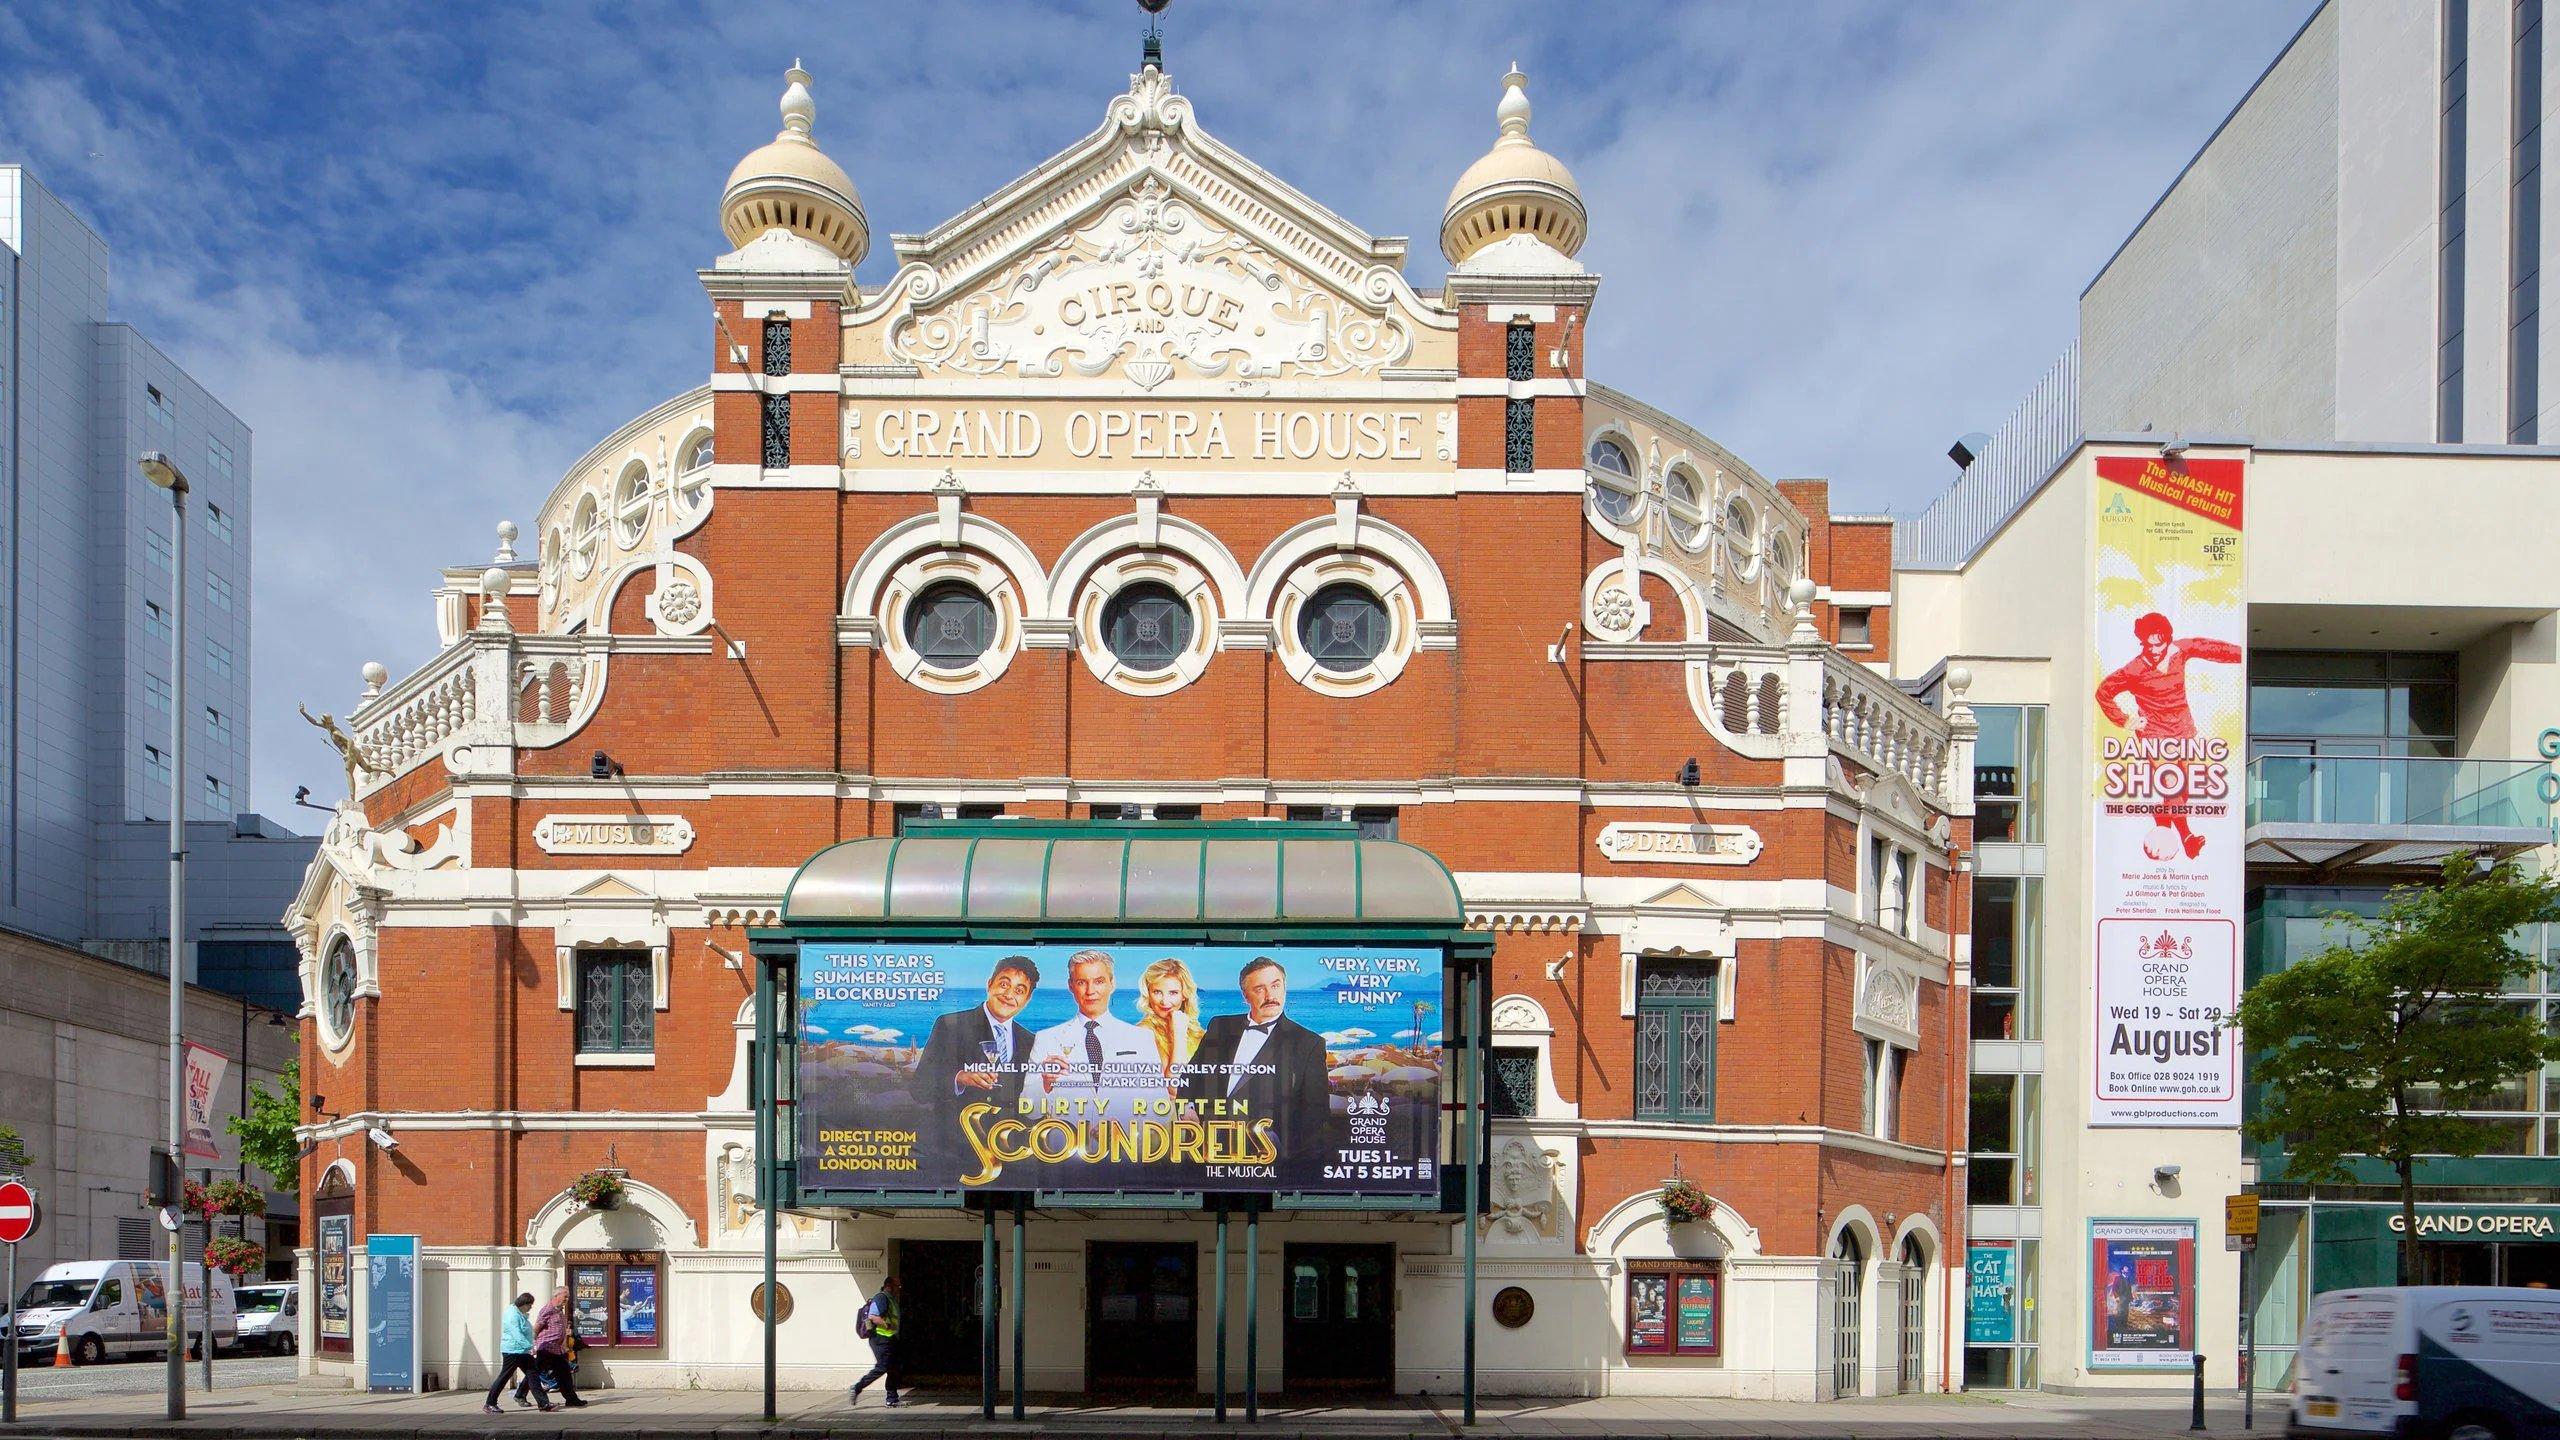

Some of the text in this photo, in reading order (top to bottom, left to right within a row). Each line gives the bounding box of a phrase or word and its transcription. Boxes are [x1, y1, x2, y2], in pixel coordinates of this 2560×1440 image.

[1058, 281, 1244, 332] CIRQUE
[1134, 318, 1165, 333] AND
[875, 410, 1423, 460] GRAND OPERA HOUSE
[2145, 461, 2236, 505] The SMASH HIT
[2138, 474, 2232, 520] Musical returns!
[2102, 515, 2134, 523] EUROPA
[2212, 537, 2237, 545] EAST
[2203, 545, 2225, 553] SIDE
[2210, 553, 2236, 561] ARTS
[2103, 737, 2229, 761] DANCING
[2104, 762, 2228, 798] SHOES
[2106, 804, 2227, 815] THE GEORGE BEST STORY
[576, 824, 654, 845] MUSIC
[1637, 832, 1721, 855] DRAMA
[2191, 874, 2209, 882] Lynch
[1375, 958, 1421, 974] VERY,
[2142, 963, 2189, 974] GRAND
[814, 971, 945, 984] SUMMER-STAGE
[1348, 975, 1392, 987] VERY
[2144, 976, 2186, 987] OPERA
[2143, 988, 2188, 996] HOUSE
[2110, 1006, 2139, 1019] Wed
[2145, 1006, 2161, 1019] 19
[2179, 1007, 2199, 1020] Sat
[2204, 1007, 2221, 1020] 29
[2110, 1023, 2222, 1063] August
[964, 1063, 1276, 1074] MICHAEL PRAED NOEL SULLIVAN CARLEY STENSON
[1102, 1077, 1137, 1087] MARK
[1140, 1078, 1190, 1087] BENTON
[2110, 1072, 2220, 1081] Box Office 028 9024 1919
[2109, 1084, 2221, 1095] Book Online www.goh.co.uk
[1018, 1098, 1249, 1115] DIRTY ROTTEN
[2111, 1109, 2219, 1119] www.gblproductions.com
[1349, 1118, 1387, 1127] GRAND
[819, 1131, 916, 1142] DIRECT FROM
[1351, 1127, 1386, 1136] OPERA
[959, 1102, 1278, 1186] SCOUNDRELS
[1350, 1136, 1386, 1144] HOUSE
[824, 1145, 911, 1156] A SOLD OUT
[1338, 1150, 1398, 1163] TUES 1-
[819, 1159, 916, 1171] LONDON RUN
[1206, 1166, 1277, 1178] THE MUSICAL
[1323, 1166, 1354, 1179] SAT
[1357, 1166, 1368, 1179] 5
[1371, 1166, 1413, 1179] SEPT
[2095, 1228, 2122, 1236] GRAND
[2125, 1228, 2149, 1236] OPERA
[2477, 1216, 2554, 1237] OPERA
[1973, 1260, 2001, 1274] CAT
[1975, 1275, 2000, 1283] IN THE
[1974, 1285, 1999, 1297] HAT
